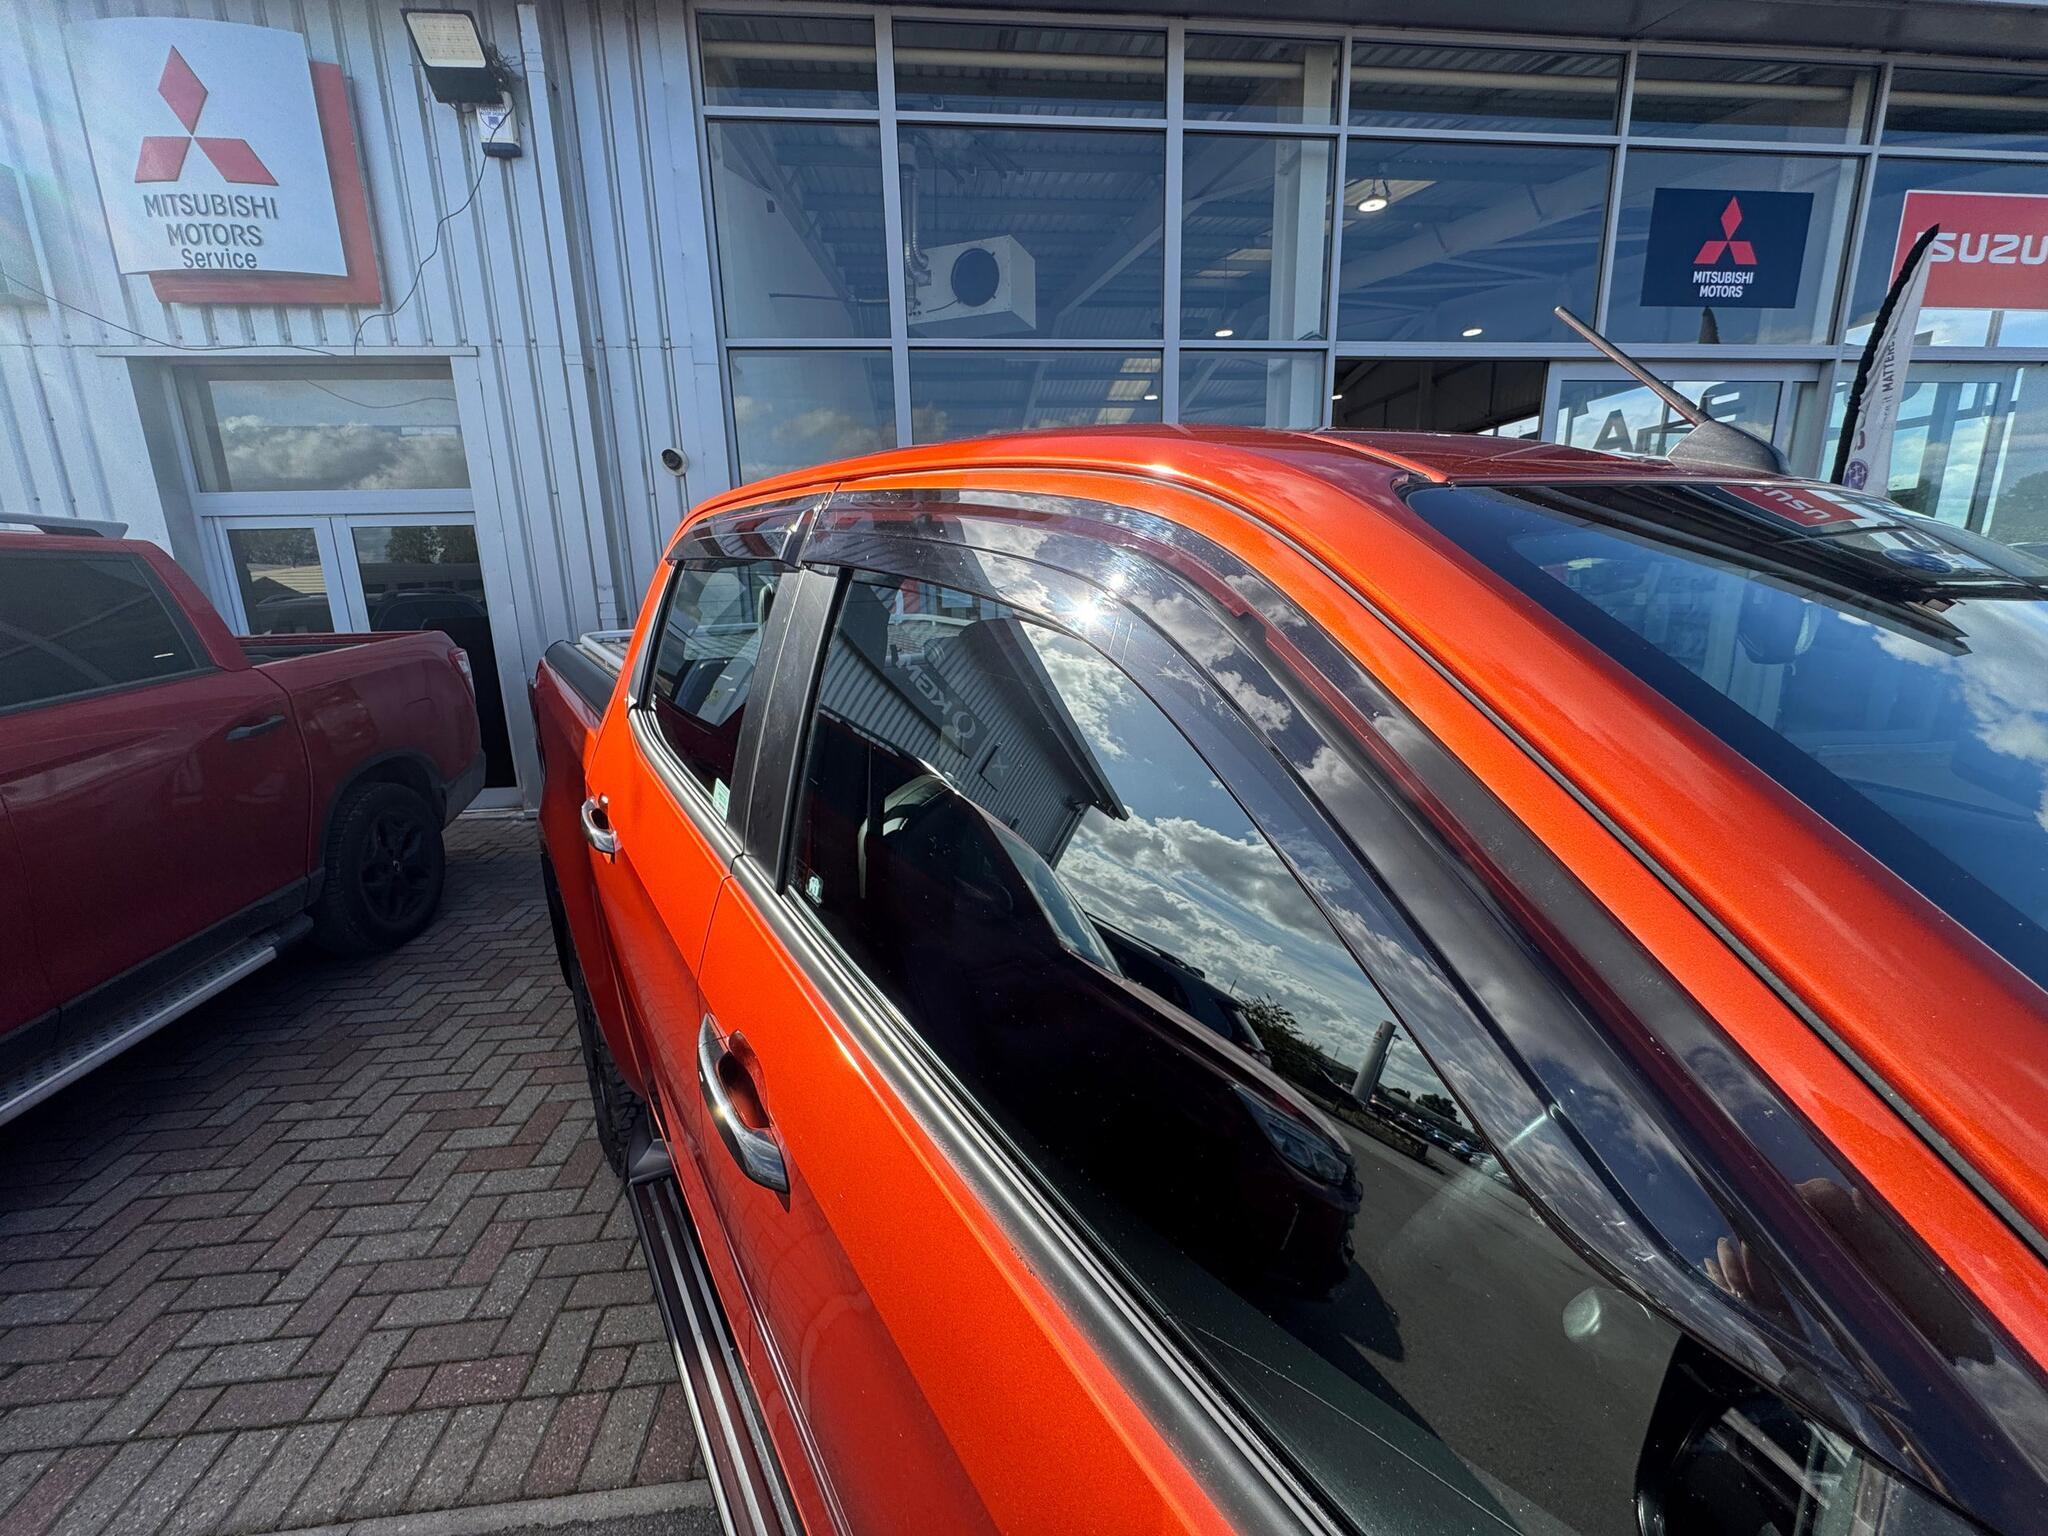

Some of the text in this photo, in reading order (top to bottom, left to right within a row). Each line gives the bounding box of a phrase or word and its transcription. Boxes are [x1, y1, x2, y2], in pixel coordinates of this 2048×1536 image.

[143, 193, 280, 219] MITSUBISHI
[166, 223, 264, 247] MOTORS
[181, 248, 258, 269] Service
[1915, 231, 2048, 265] SUZU
[1692, 271, 1754, 284] MITSUBISHI
[1699, 285, 1743, 298] MOTORS
